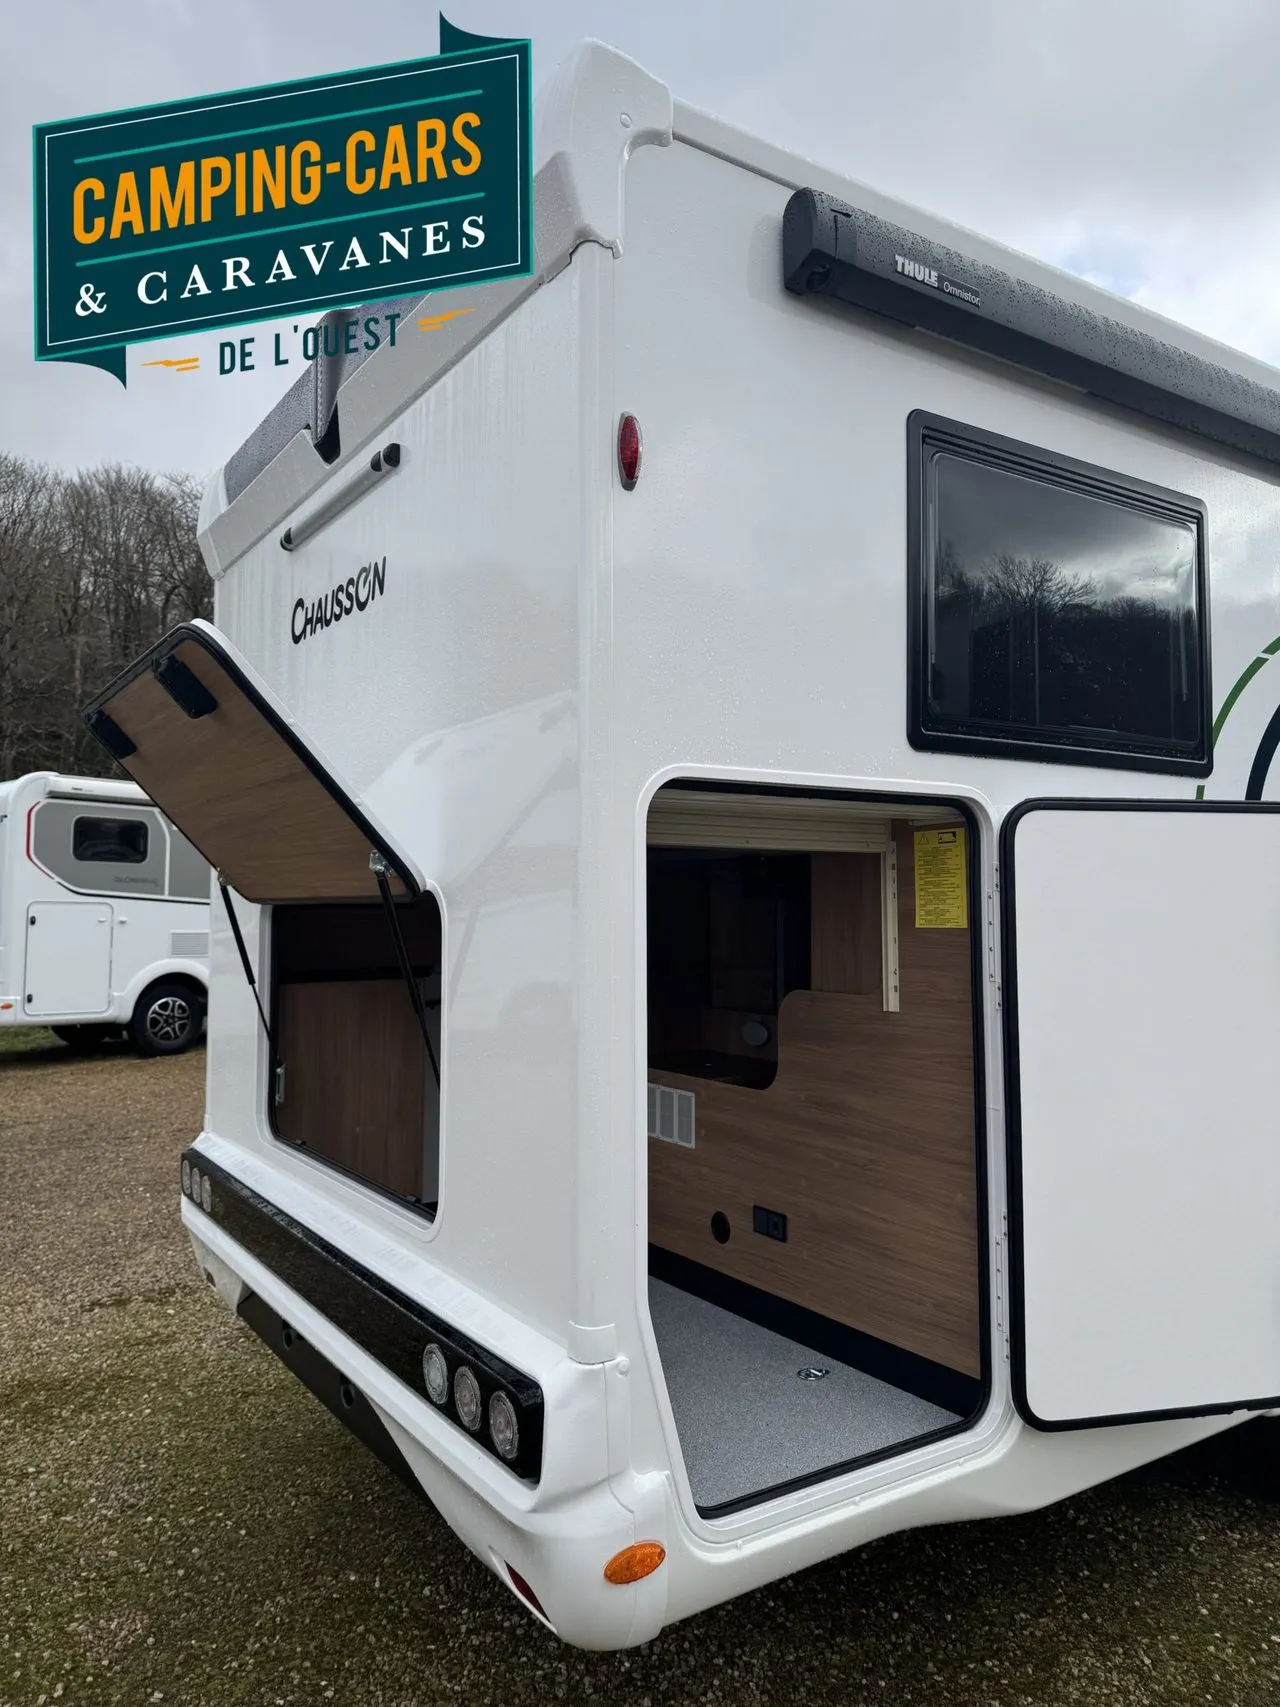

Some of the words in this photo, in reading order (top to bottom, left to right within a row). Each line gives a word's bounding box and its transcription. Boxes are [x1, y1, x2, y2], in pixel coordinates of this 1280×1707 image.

[894, 253, 939, 288] THULE
[943, 281, 980, 306] Omnistor
[291, 555, 387, 645] CHAUSSON
